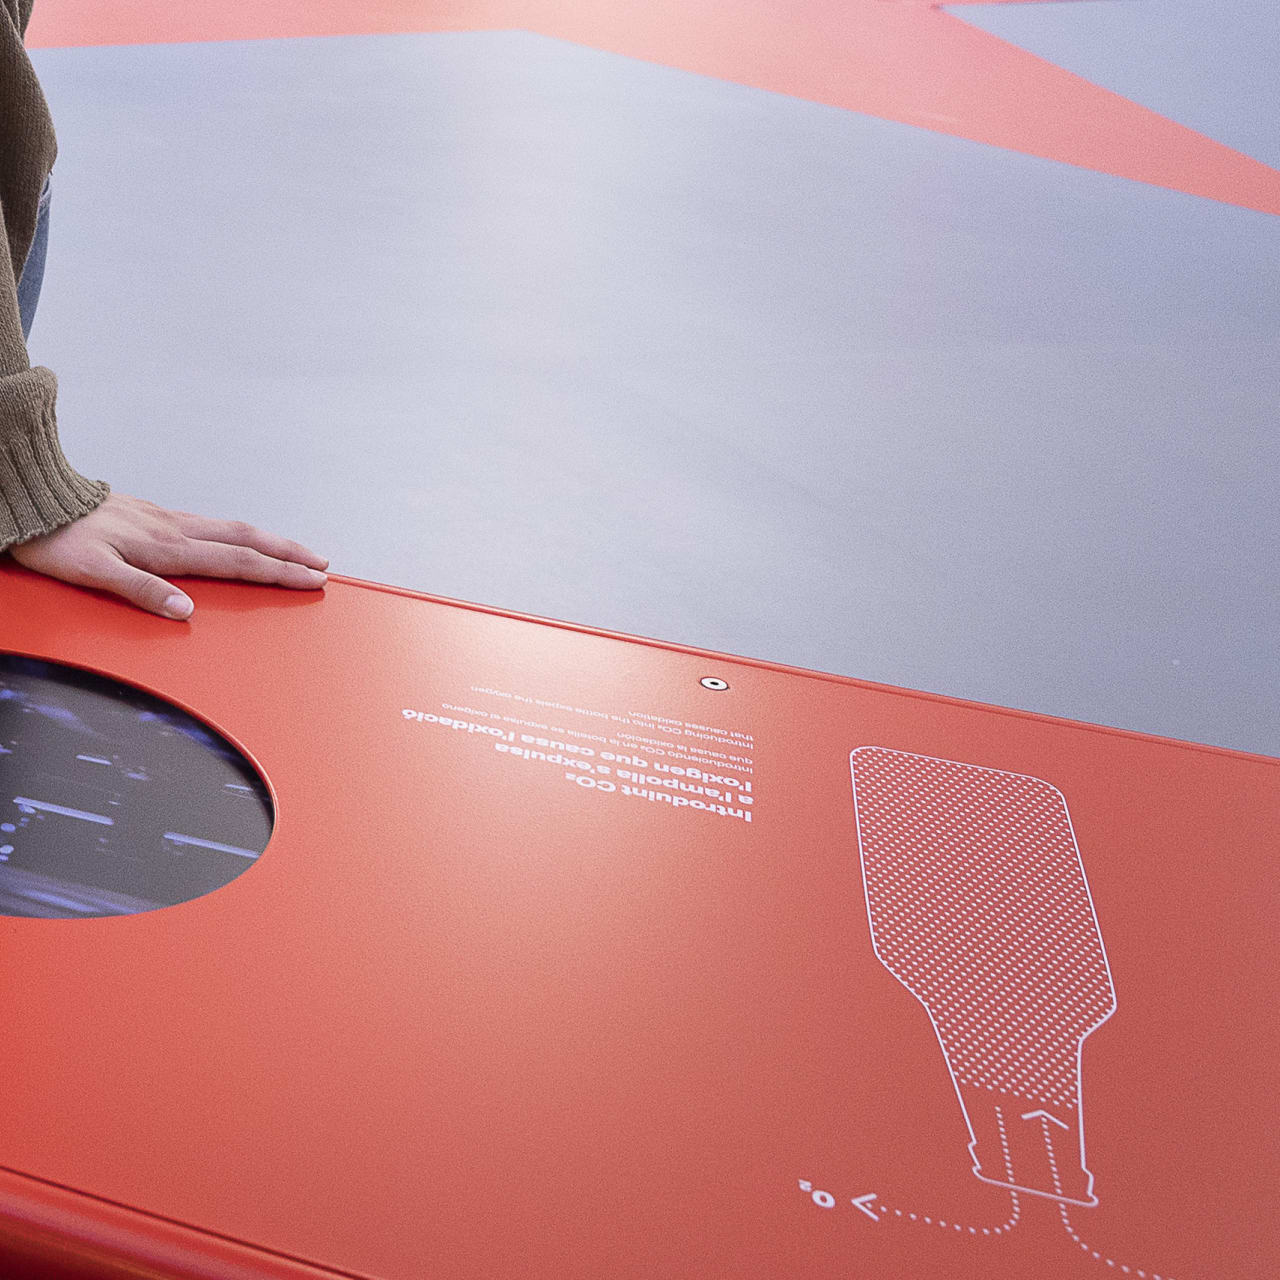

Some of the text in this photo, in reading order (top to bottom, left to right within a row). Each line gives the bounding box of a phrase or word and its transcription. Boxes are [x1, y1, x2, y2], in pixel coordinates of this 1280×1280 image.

[521, 734, 595, 756] causa
[600, 752, 648, 768] que
[621, 784, 751, 822] Introduint
[738, 794, 754, 805] a
